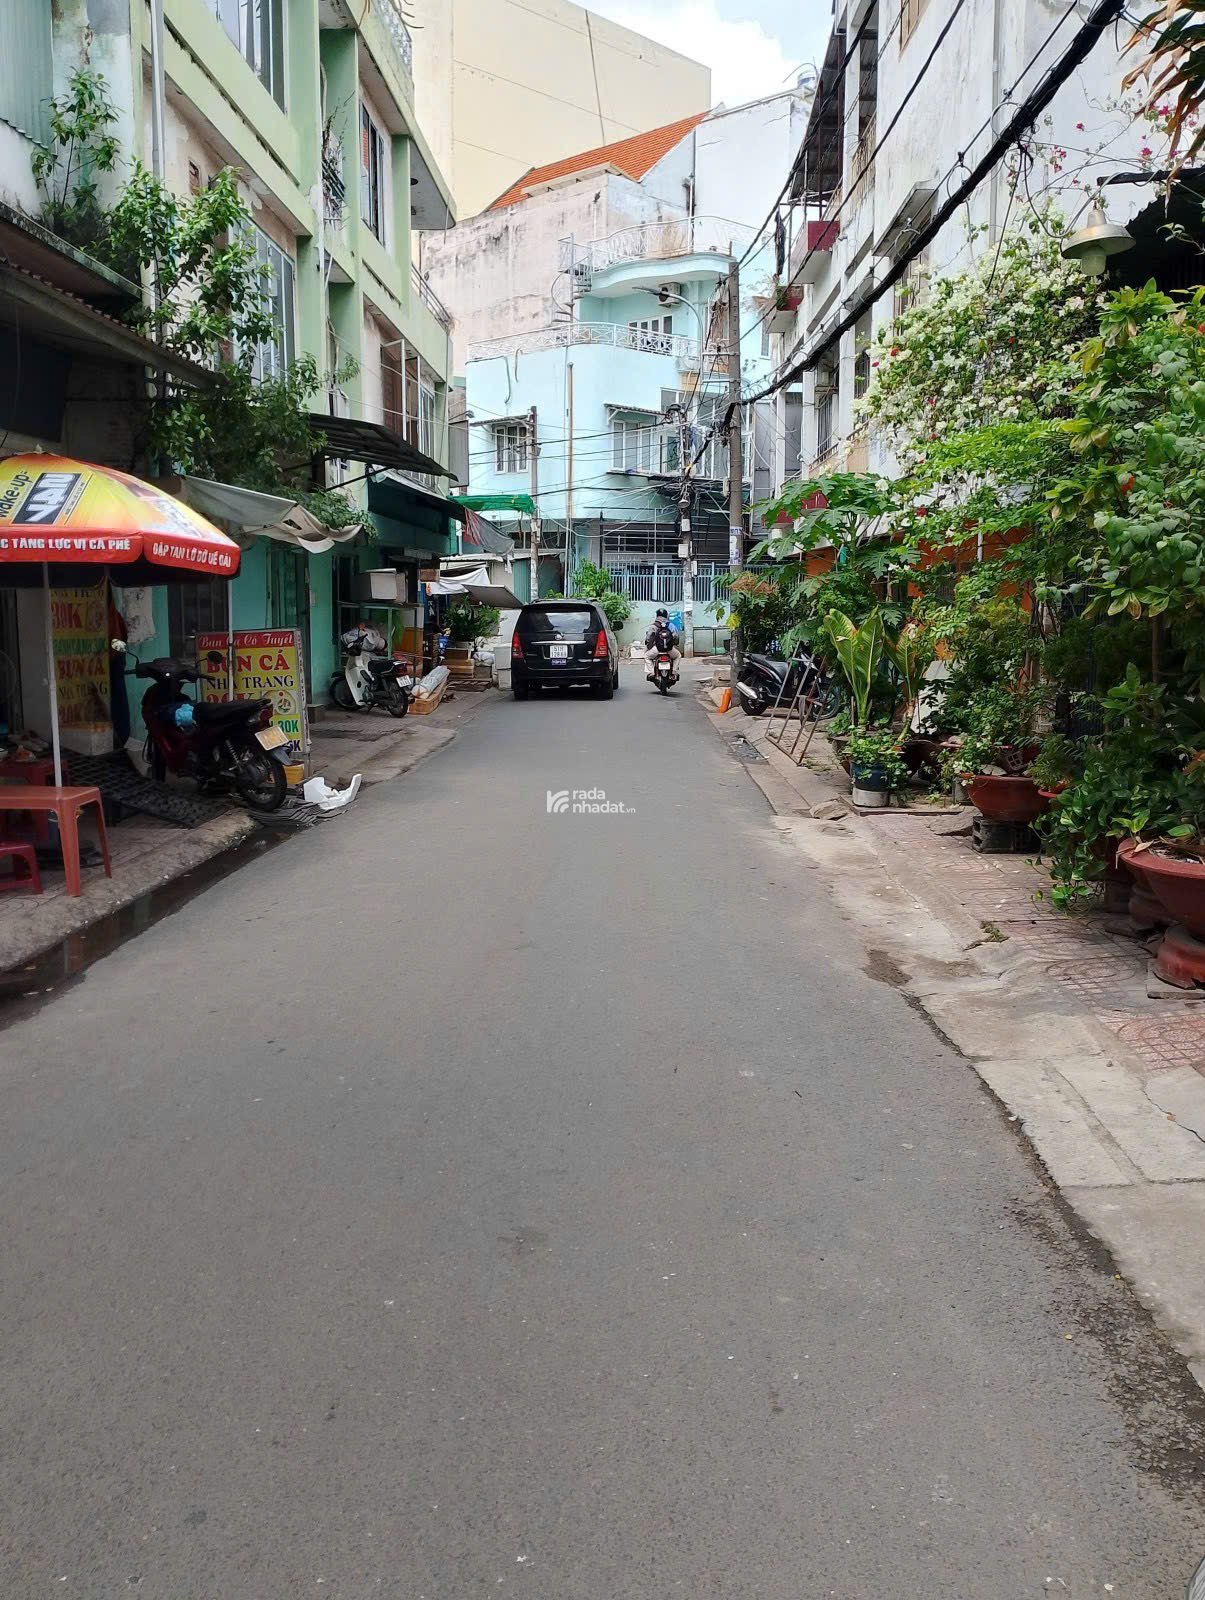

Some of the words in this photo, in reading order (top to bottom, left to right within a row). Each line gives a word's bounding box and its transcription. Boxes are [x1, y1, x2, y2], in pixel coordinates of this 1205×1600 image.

[12, 538, 45, 550] TĂNG
[259, 649, 291, 672] CÁ
[242, 675, 294, 689] TRANG
